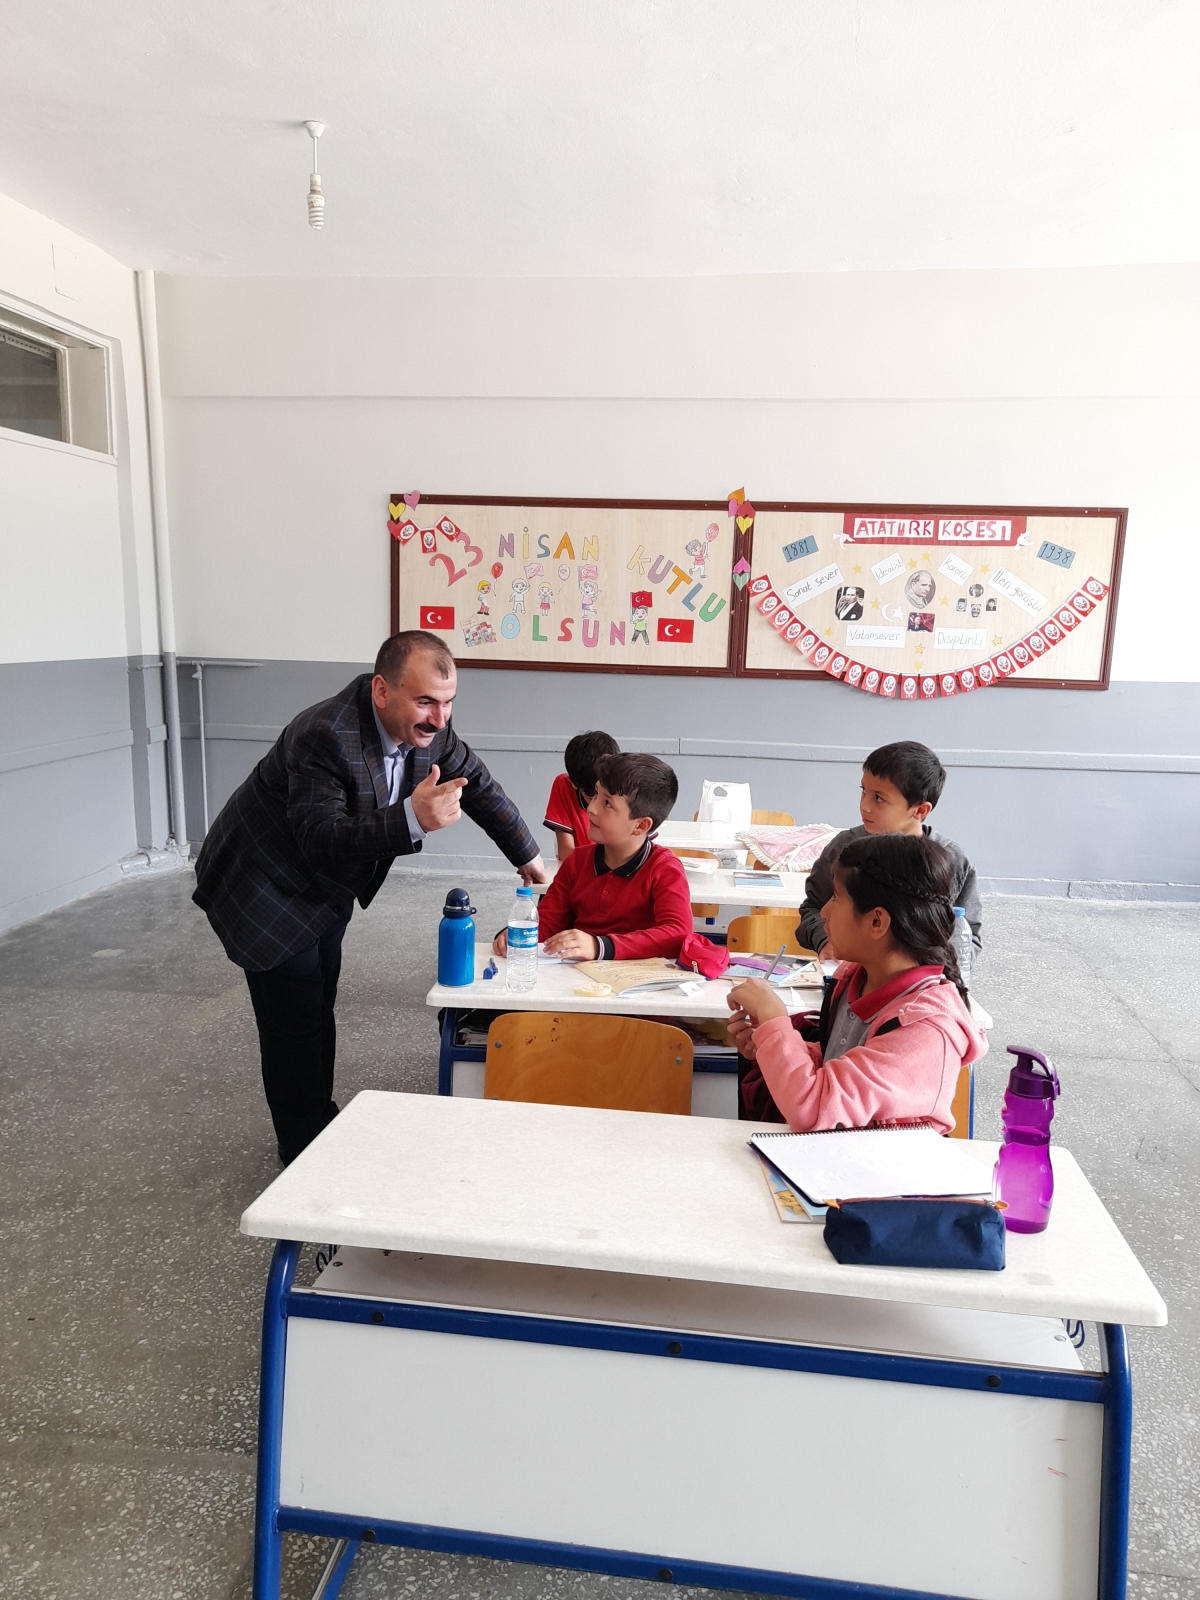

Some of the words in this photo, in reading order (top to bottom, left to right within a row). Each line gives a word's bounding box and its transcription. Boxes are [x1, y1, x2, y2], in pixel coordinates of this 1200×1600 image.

[785, 539, 809, 560] 1881
[1039, 543, 1072, 564] 1938
[429, 532, 483, 588] 23
[498, 526, 599, 561] NİSAN
[627, 545, 727, 623] KUTLU
[501, 613, 626, 648] OLSUN
